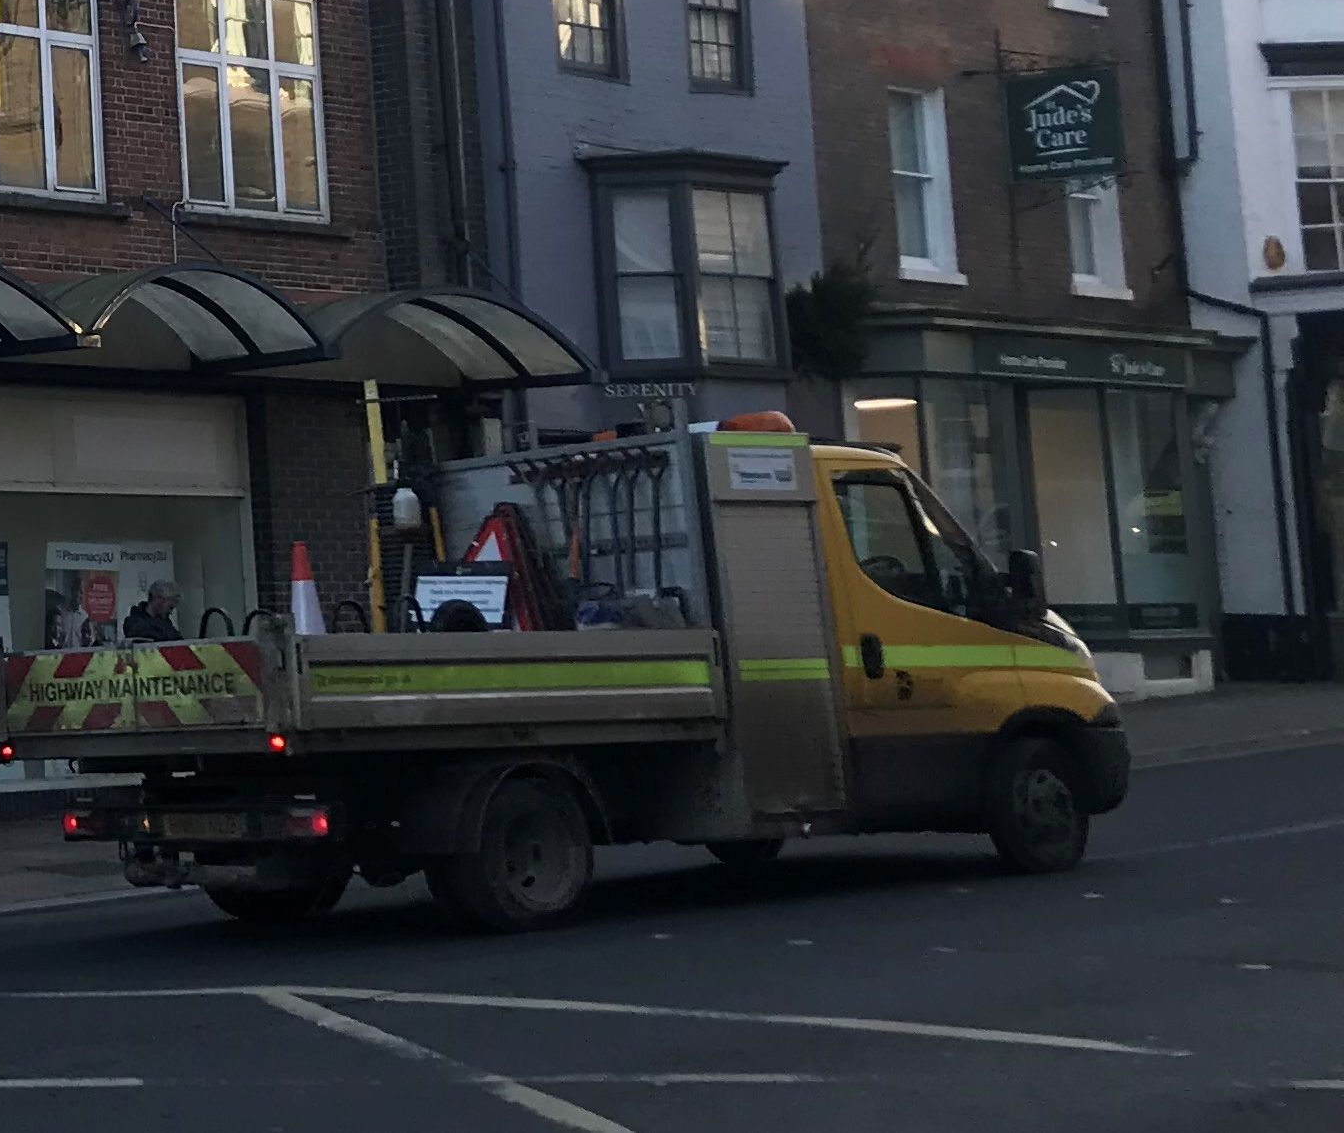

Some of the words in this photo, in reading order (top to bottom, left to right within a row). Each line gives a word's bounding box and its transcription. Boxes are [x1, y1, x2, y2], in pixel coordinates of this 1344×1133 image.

[1025, 103, 1094, 132] Jude's
[1036, 128, 1088, 148] Care
[604, 382, 698, 398] SERENITY
[62, 549, 115, 565] Pharmacy2U
[29, 679, 104, 703] HIGHWAY
[108, 673, 235, 699] MAINTENANCE
